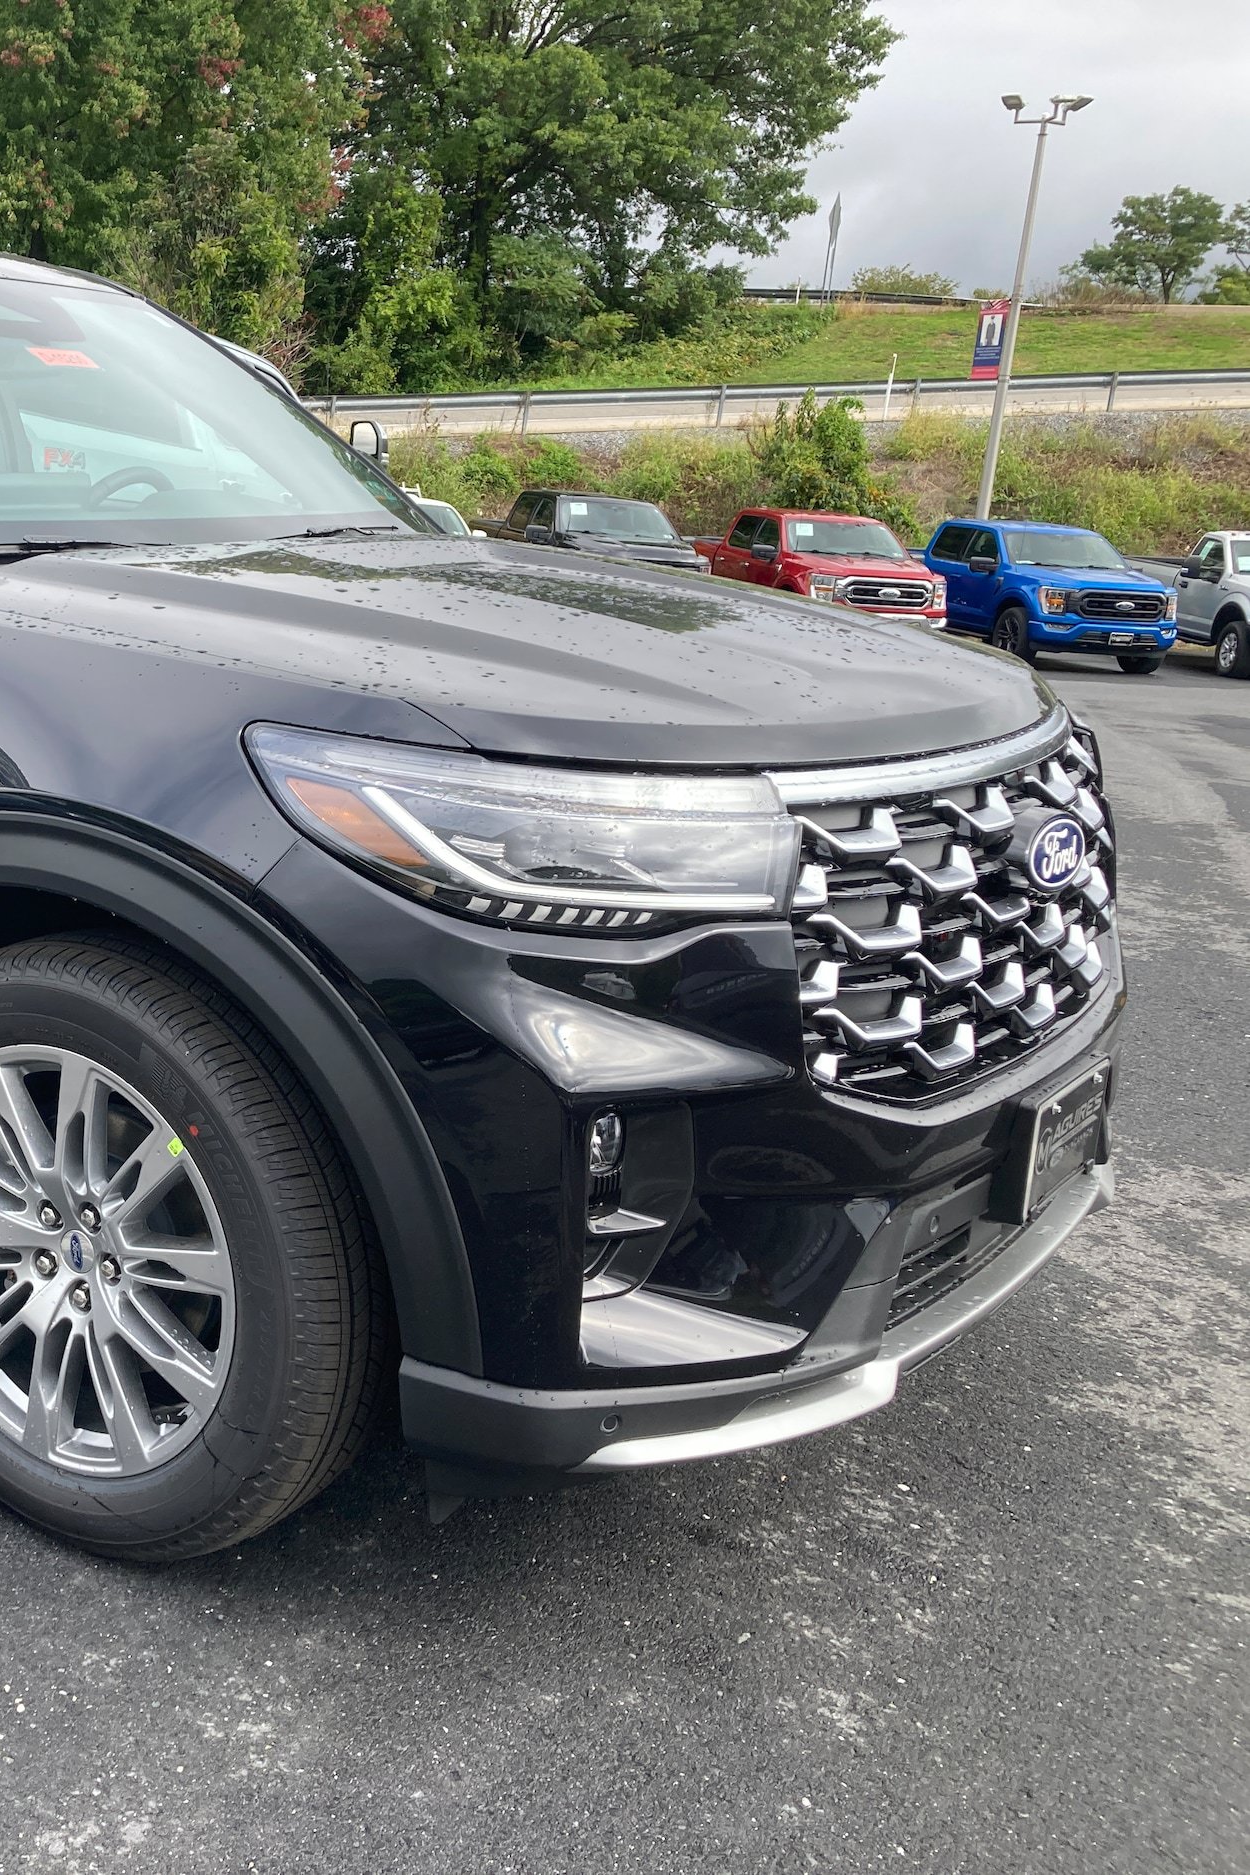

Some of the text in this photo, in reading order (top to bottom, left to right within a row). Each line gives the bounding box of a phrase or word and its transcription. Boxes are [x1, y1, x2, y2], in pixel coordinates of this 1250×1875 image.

[43, 447, 85, 470] FX4
[1042, 827, 1078, 880] Ford
[187, 1111, 271, 1280] MICHELIN
